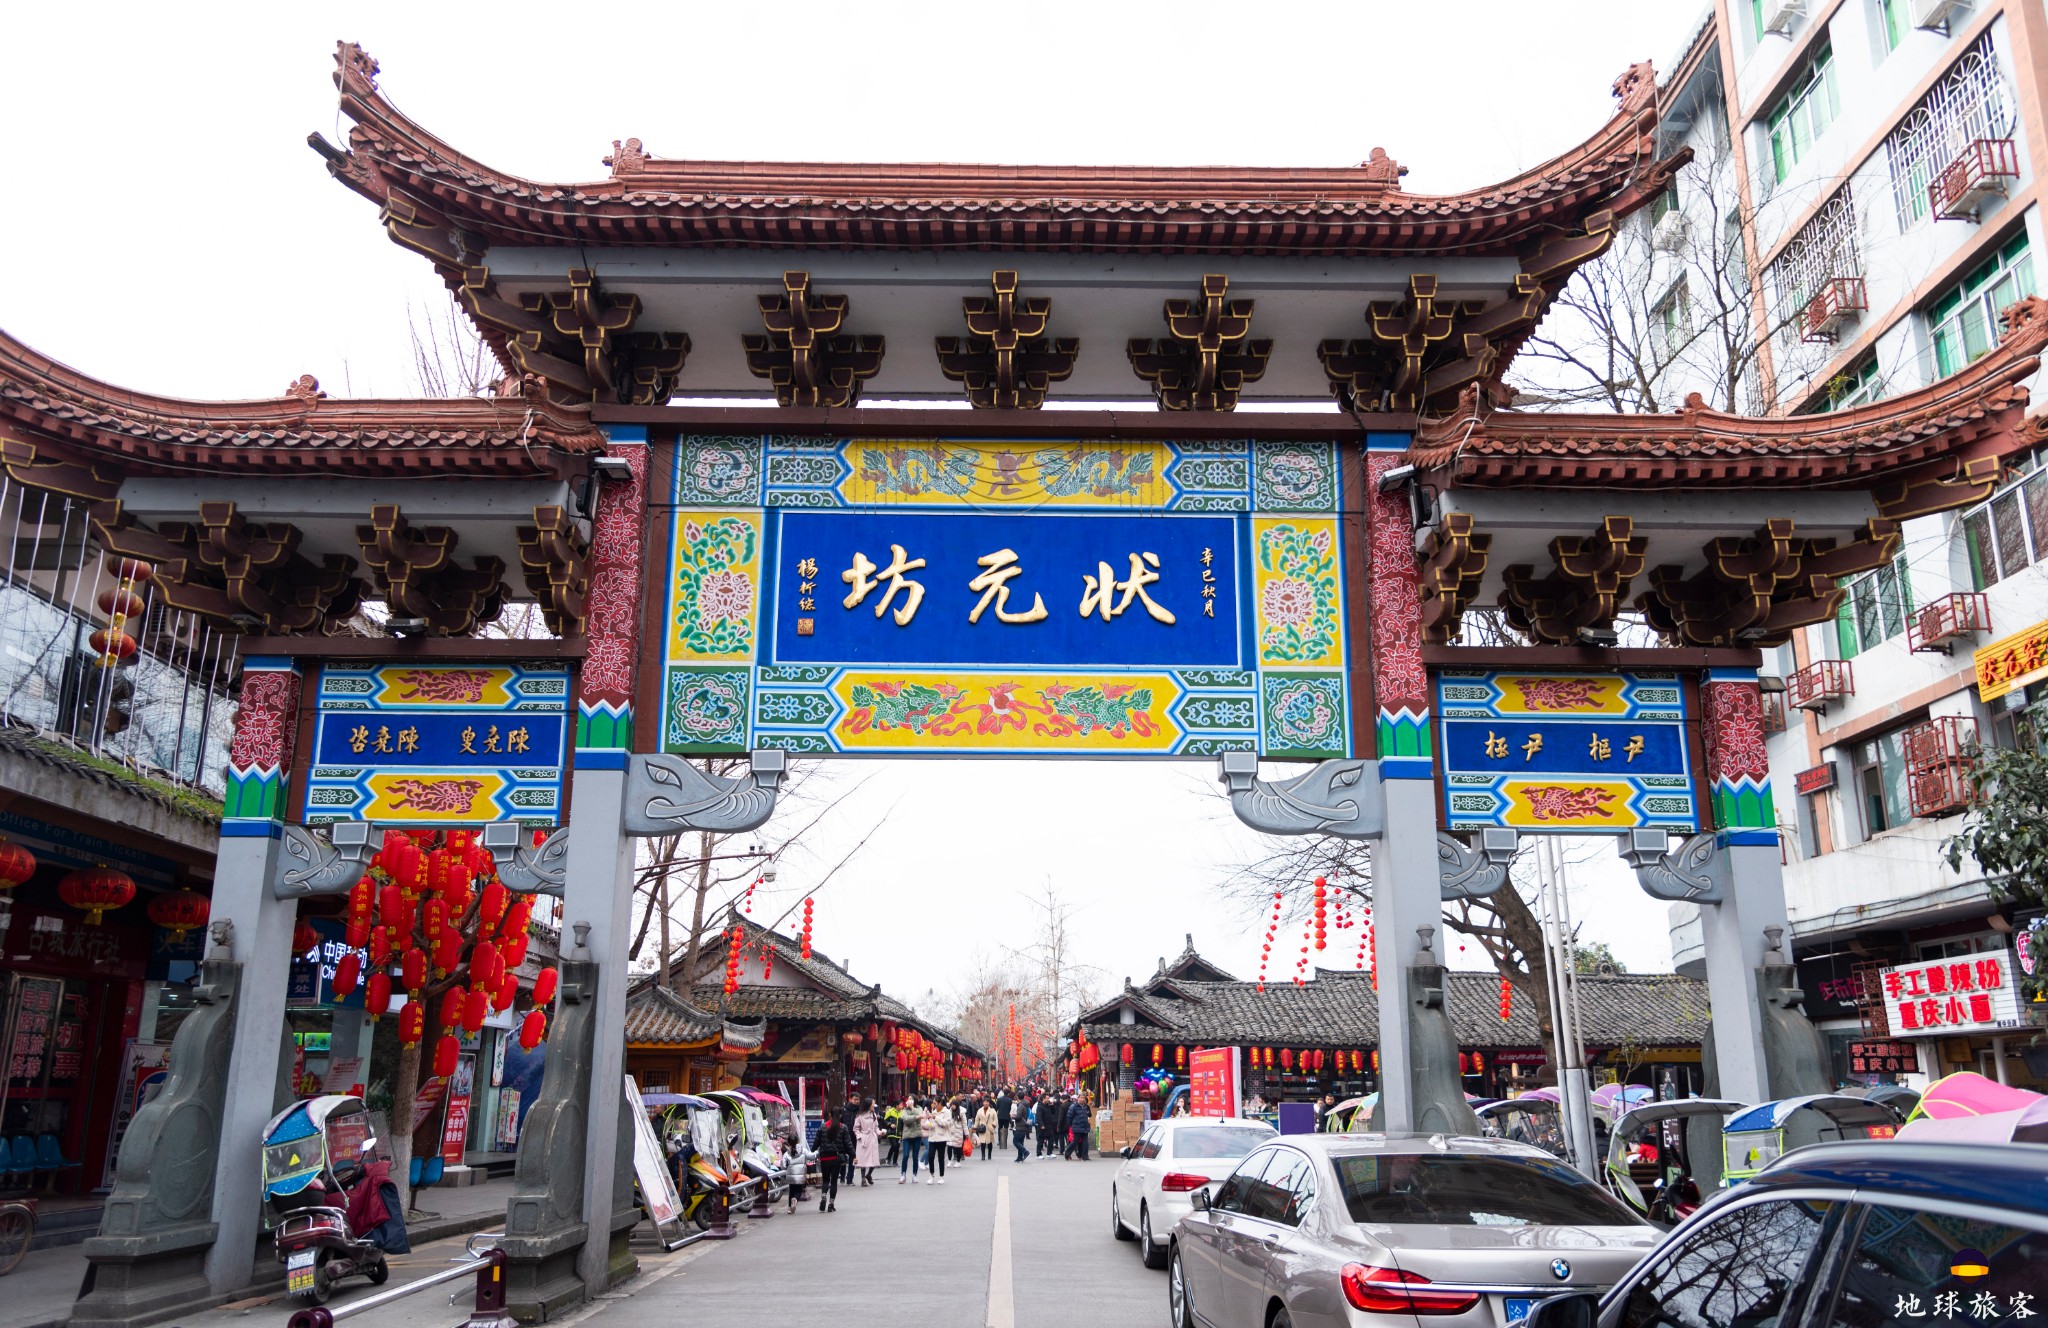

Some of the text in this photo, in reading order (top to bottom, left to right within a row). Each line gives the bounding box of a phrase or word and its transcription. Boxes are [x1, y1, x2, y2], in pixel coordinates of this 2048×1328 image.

[841, 543, 1176, 626] 状元坊
[1885, 959, 2001, 998] 手工酸辣粉
[1899, 994, 1992, 1029] 重庆小面
[1853, 1057, 1915, 1071] 重庆小面
